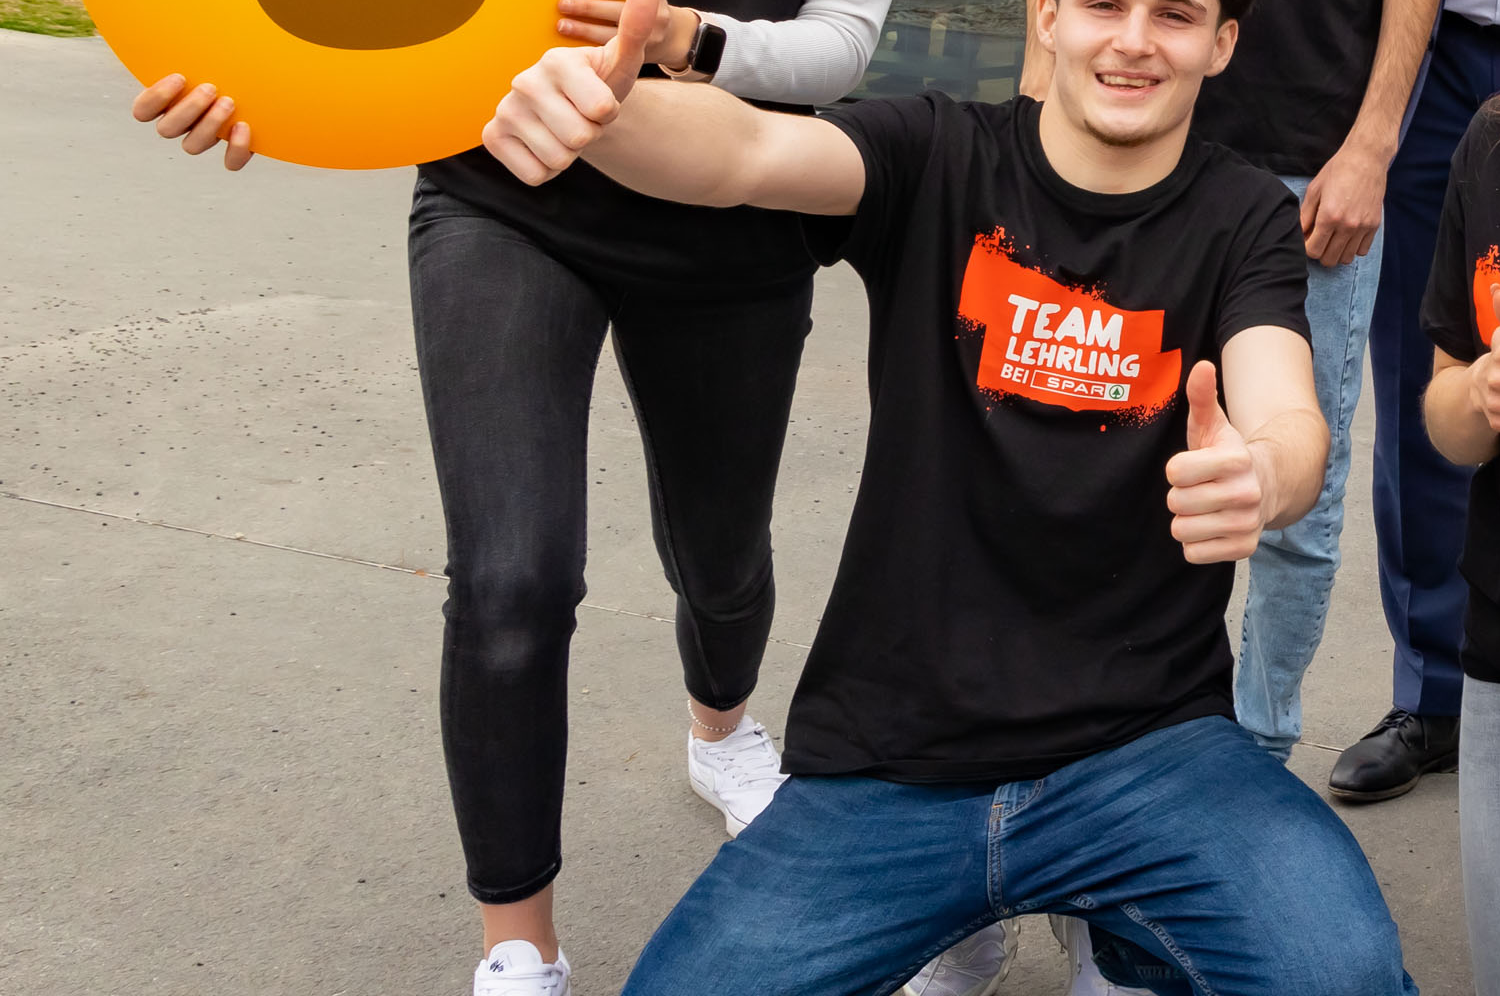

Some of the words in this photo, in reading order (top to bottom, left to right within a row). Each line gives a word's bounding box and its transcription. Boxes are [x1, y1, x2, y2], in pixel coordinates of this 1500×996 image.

[1007, 293, 1124, 352] TEAM
[1005, 336, 1141, 378] LEHRLING
[1000, 363, 1030, 384] BEI
[1046, 377, 1104, 396] SPAR
